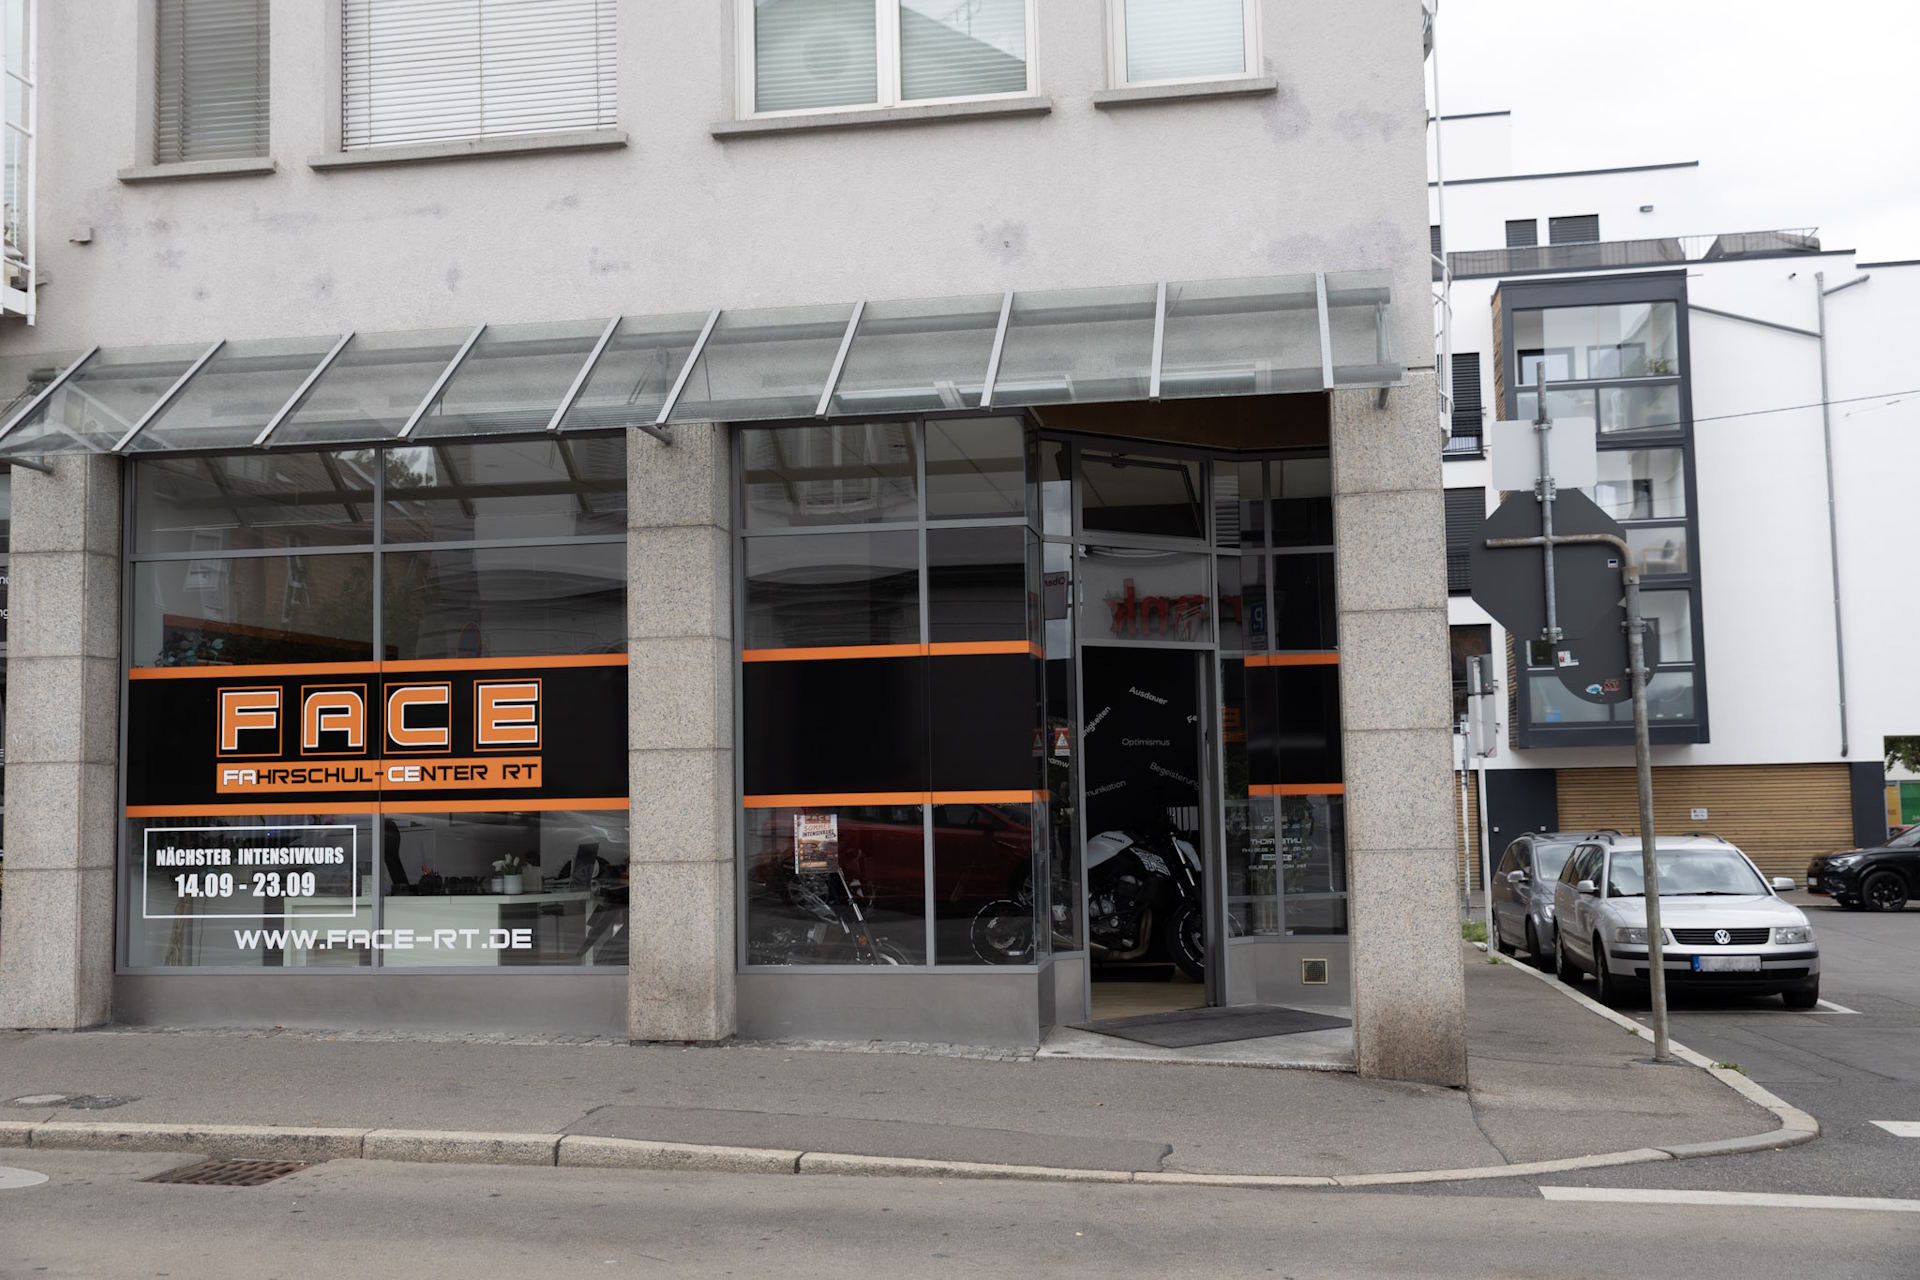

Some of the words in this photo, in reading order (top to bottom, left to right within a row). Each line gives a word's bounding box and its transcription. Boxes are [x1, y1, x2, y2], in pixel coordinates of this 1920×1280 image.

[1129, 686, 1168, 705] Ausdauer
[221, 684, 539, 750] FACE
[1122, 738, 1170, 747] Optimismus
[1048, 756, 1070, 769] amw
[223, 764, 489, 786] FAHRSCHUL-CENTER
[502, 763, 538, 780] RT
[1150, 762, 1200, 790] Begeisterung
[156, 847, 231, 866] NÄCHSTER
[238, 847, 344, 865] INTENSIVKURS
[175, 873, 233, 898] 14.09
[253, 872, 316, 897] 23.09
[234, 928, 533, 950] WWW.FACE-RT.DE
